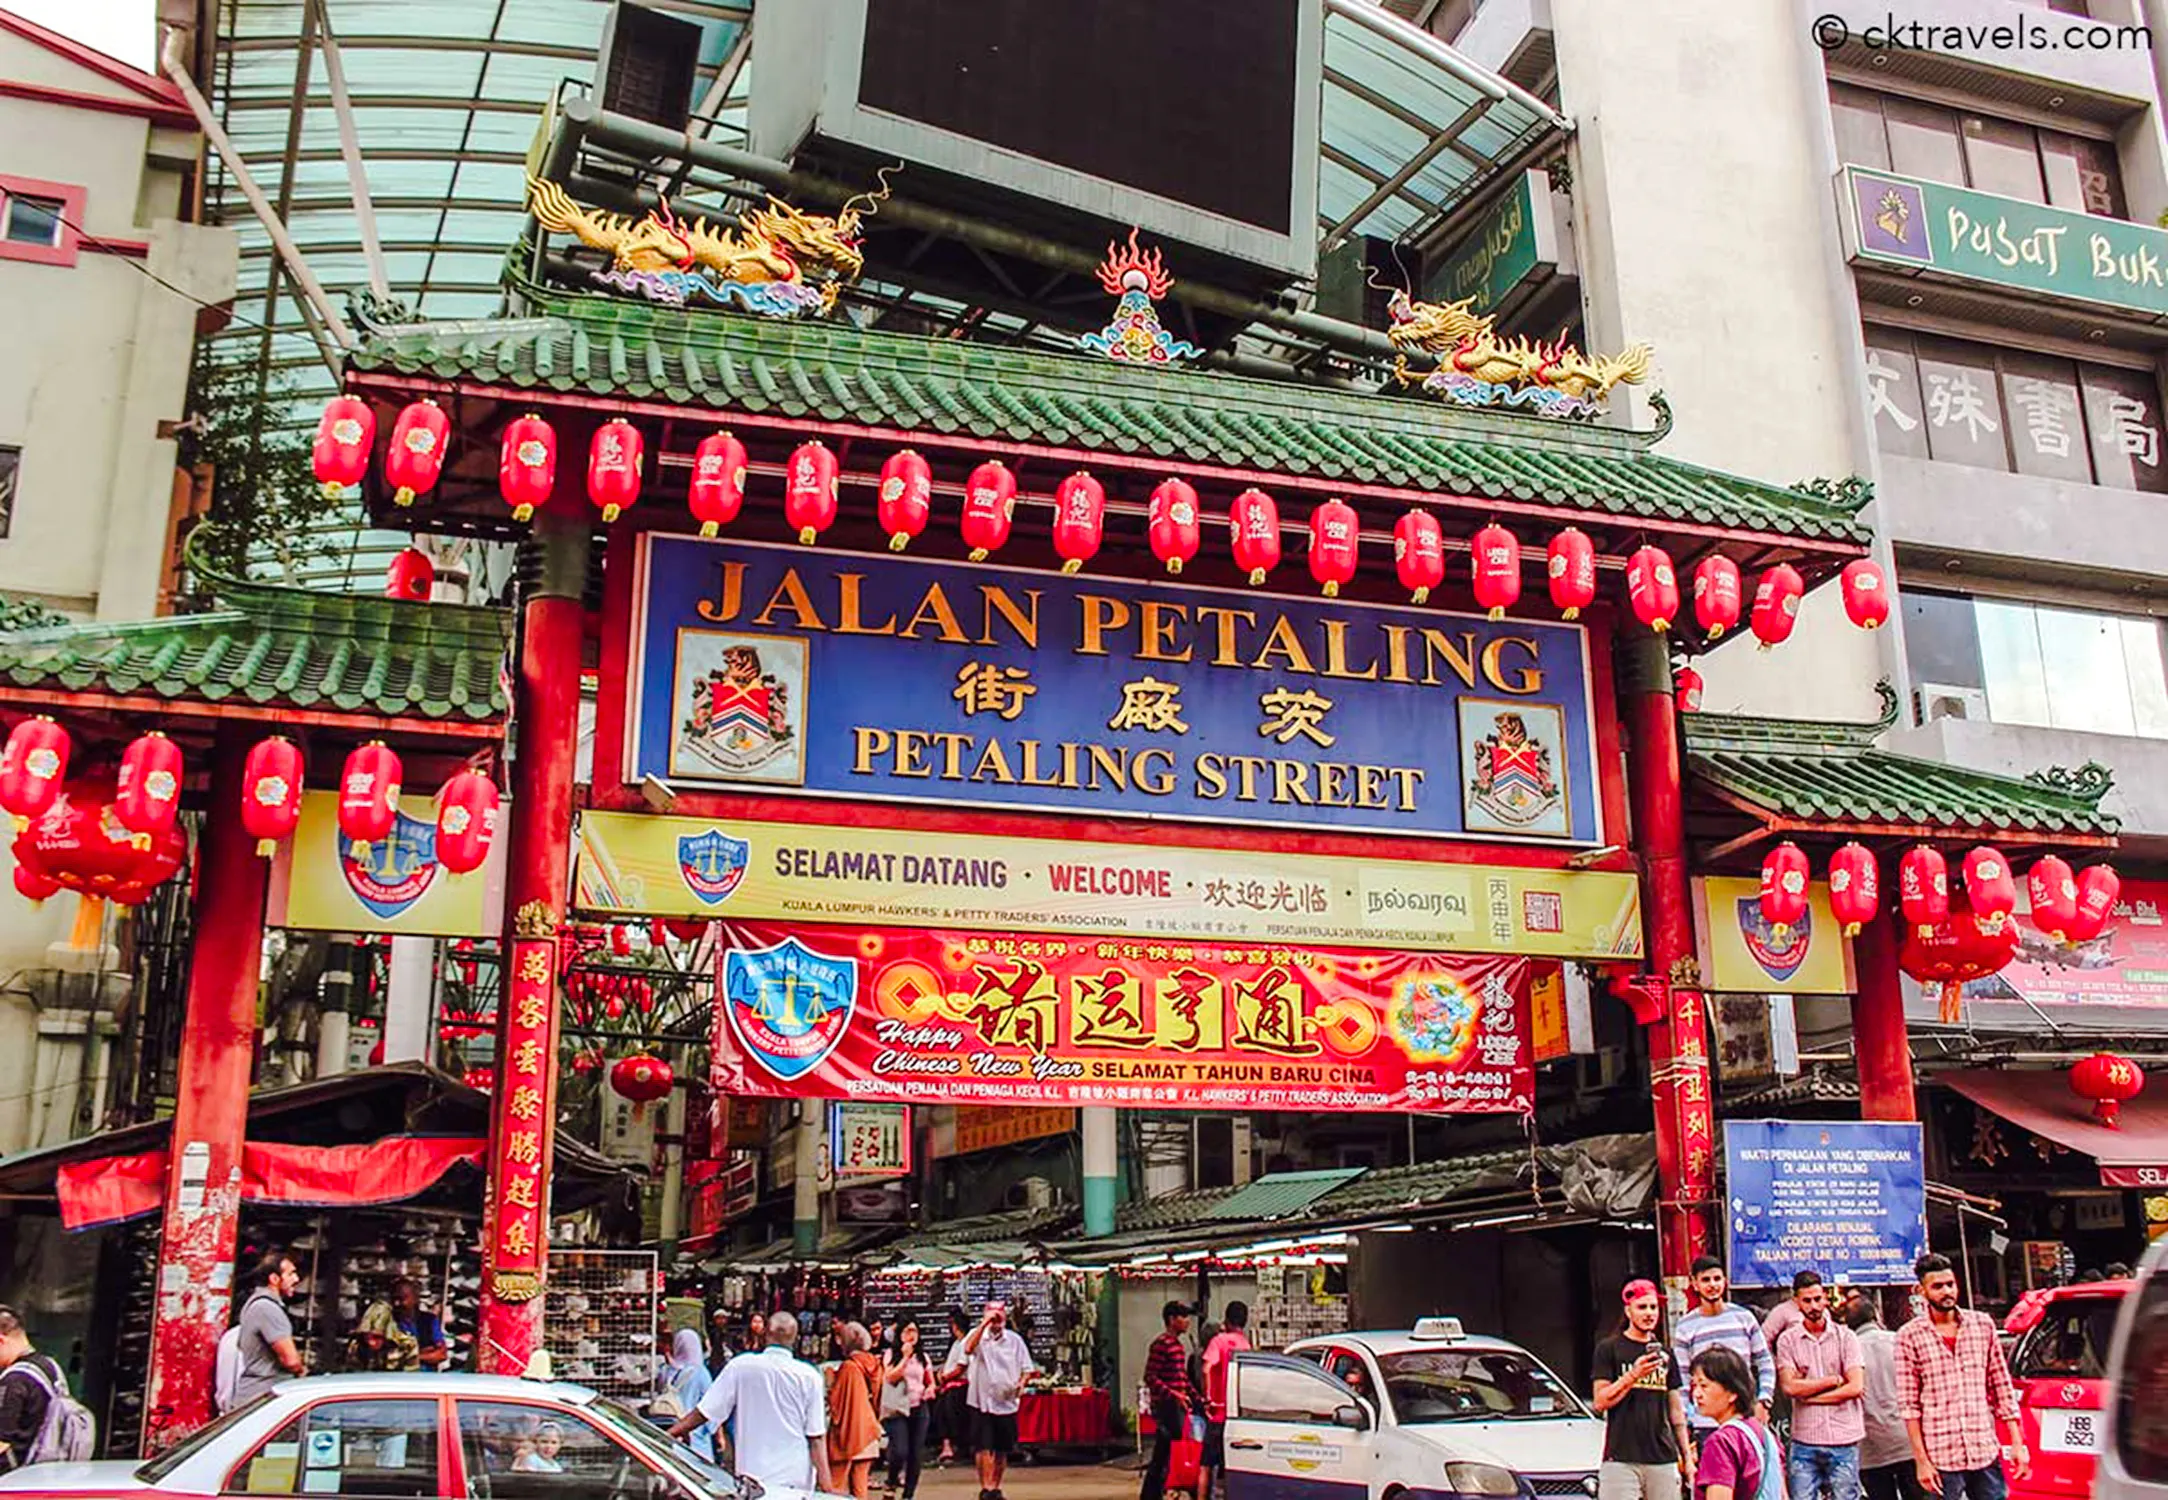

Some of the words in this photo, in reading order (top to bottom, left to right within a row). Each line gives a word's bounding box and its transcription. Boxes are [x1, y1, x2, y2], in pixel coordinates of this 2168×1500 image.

[2089, 231, 2168, 288] Buk
[697, 560, 1043, 648] JALAN
[1075, 594, 1545, 695] PETALING
[852, 726, 1177, 796] PETALING
[1196, 752, 1426, 812] STREET
[776, 847, 896, 884] SELAMAT
[902, 856, 1008, 888] DATANG
[1049, 864, 1172, 898] WELCOME
[1202, 877, 1329, 914] 欢迎光临
[1488, 879, 1512, 942] 丙申年
[782, 900, 823, 913] KUALA
[825, 902, 876, 914] LUMPUR
[953, 908, 993, 919] PETTY
[1052, 913, 1127, 927] ASSOCIATION
[1096, 943, 1196, 962] 新年快樂
[874, 1019, 963, 1050] Happy
[871, 1050, 960, 1074] Chinese
[969, 1052, 1022, 1076] New
[1024, 1053, 1084, 1081] Year
[1092, 1061, 1186, 1081] SELAMAT
[1197, 1065, 1263, 1081] TAHUN
[1270, 1067, 1323, 1083] BARU
[1330, 1068, 1376, 1084] CINA
[845, 1080, 904, 1095] PERSATUAN
[906, 1082, 948, 1096] PENJAJA
[950, 1083, 972, 1097] DAN
[1795, 1163, 1825, 1174] JALAN
[1827, 1163, 1869, 1174] PETALING
[1793, 1249, 1811, 1260] HOT
